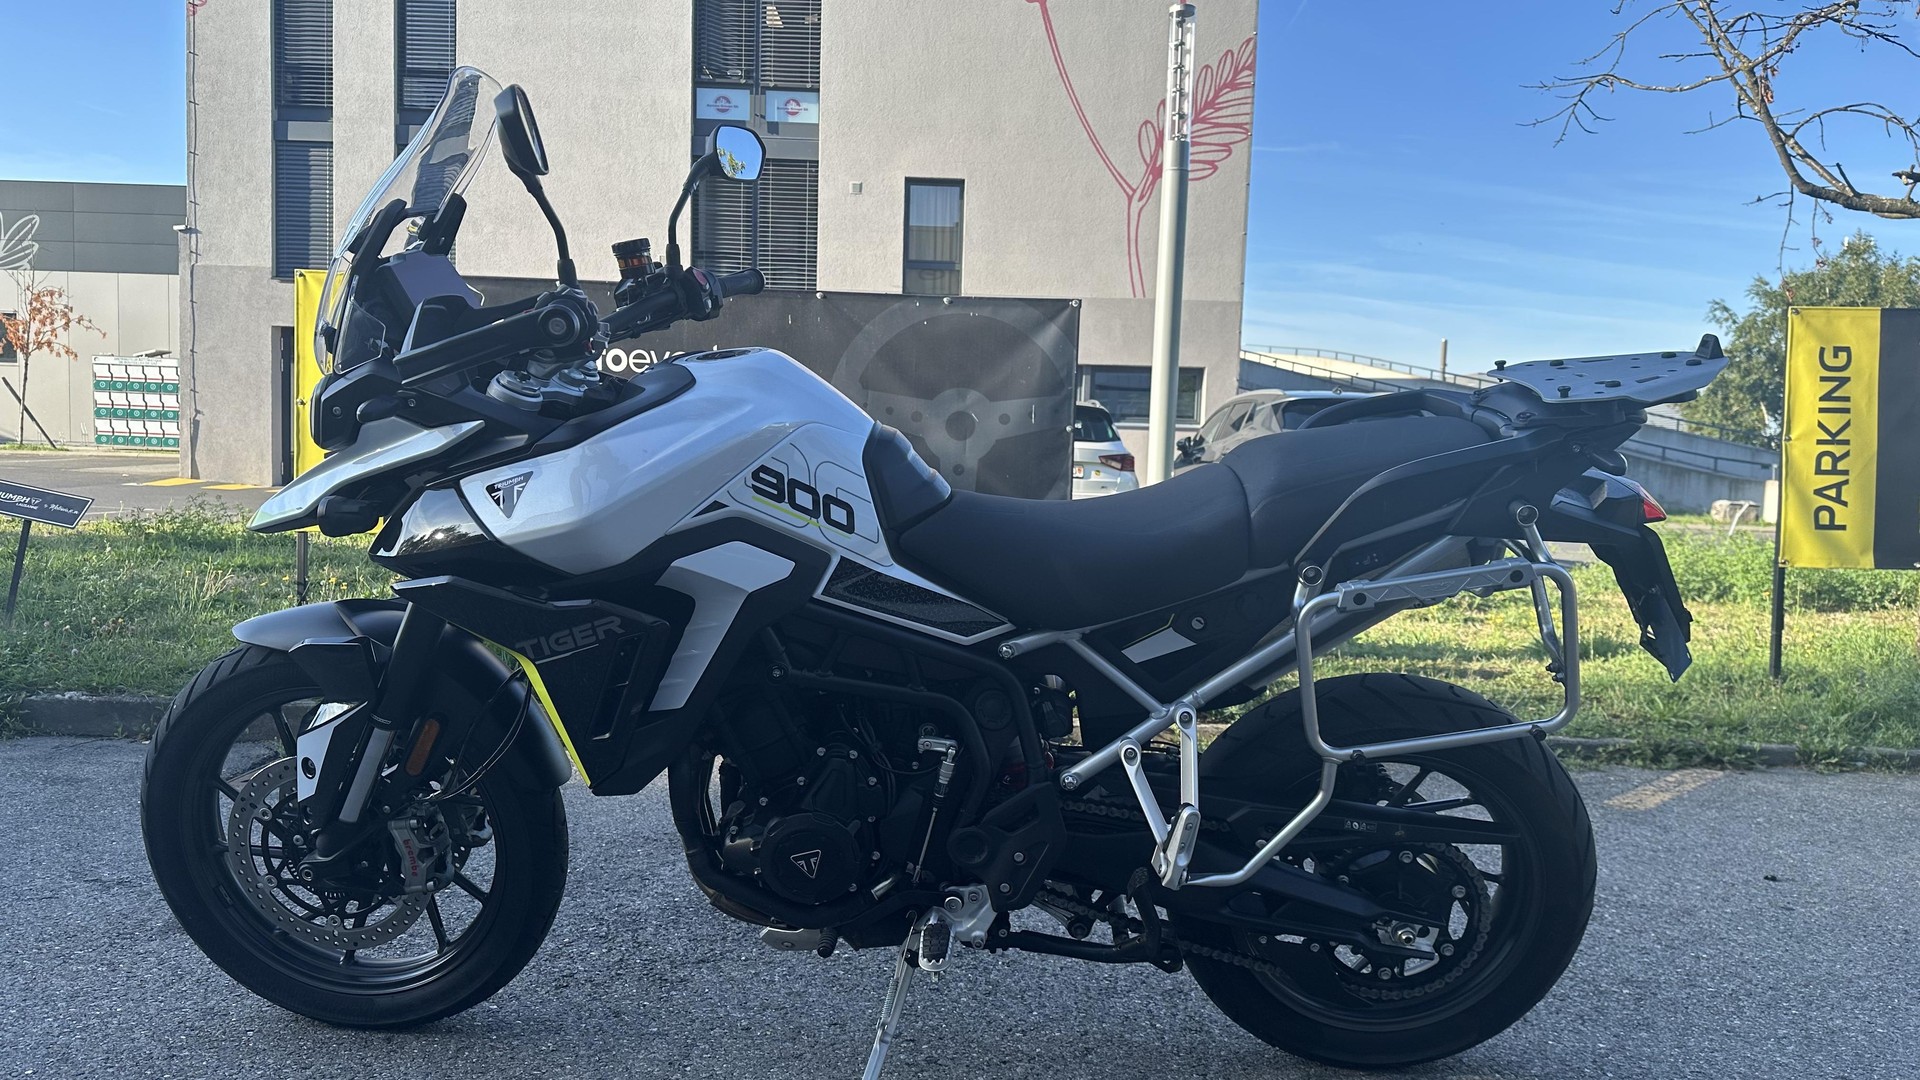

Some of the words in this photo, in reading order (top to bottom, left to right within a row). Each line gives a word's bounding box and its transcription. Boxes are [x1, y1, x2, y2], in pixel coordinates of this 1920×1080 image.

[1813, 345, 1852, 531] PARKING
[494, 476, 523, 489] TRIUMPH
[751, 464, 855, 534] 900
[515, 615, 626, 659] TIGER
